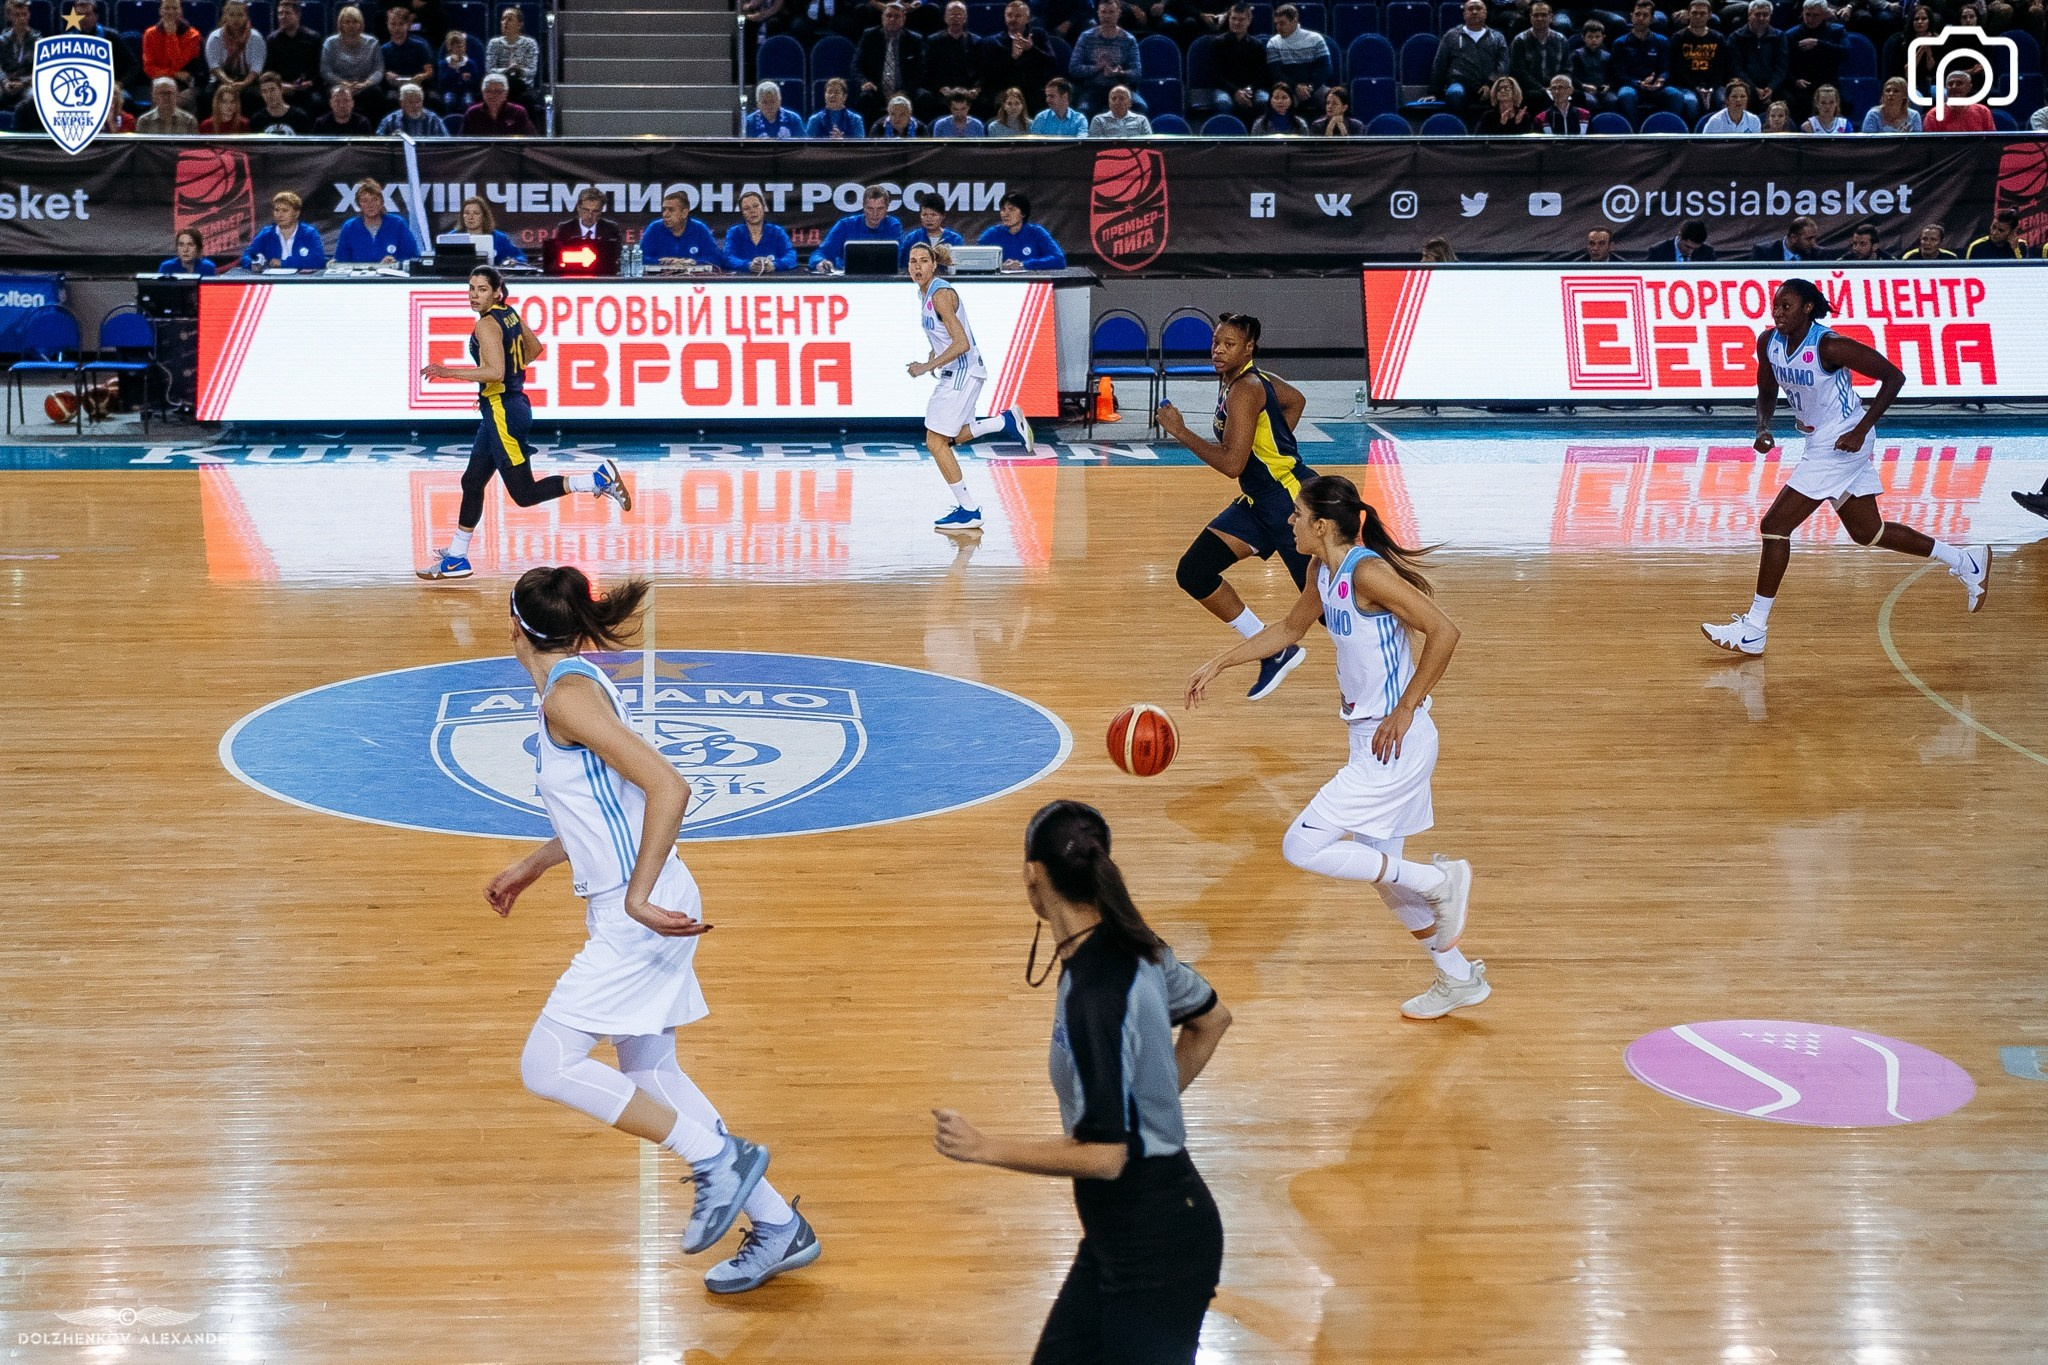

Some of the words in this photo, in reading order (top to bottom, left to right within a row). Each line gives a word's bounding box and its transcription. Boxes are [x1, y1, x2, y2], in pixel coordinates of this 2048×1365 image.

[0, 184, 90, 221] sket
[1601, 181, 1914, 224] @russiabasket
[1111, 228, 1155, 258] ЛИГА
[725, 294, 849, 341] ЦЕНТР
[1645, 271, 1855, 320] ТОРГОЙ
[1863, 276, 1986, 325] ЦЕНТР
[1652, 322, 1998, 388] ЕВОПА
[1771, 361, 1815, 387] YNAMO
